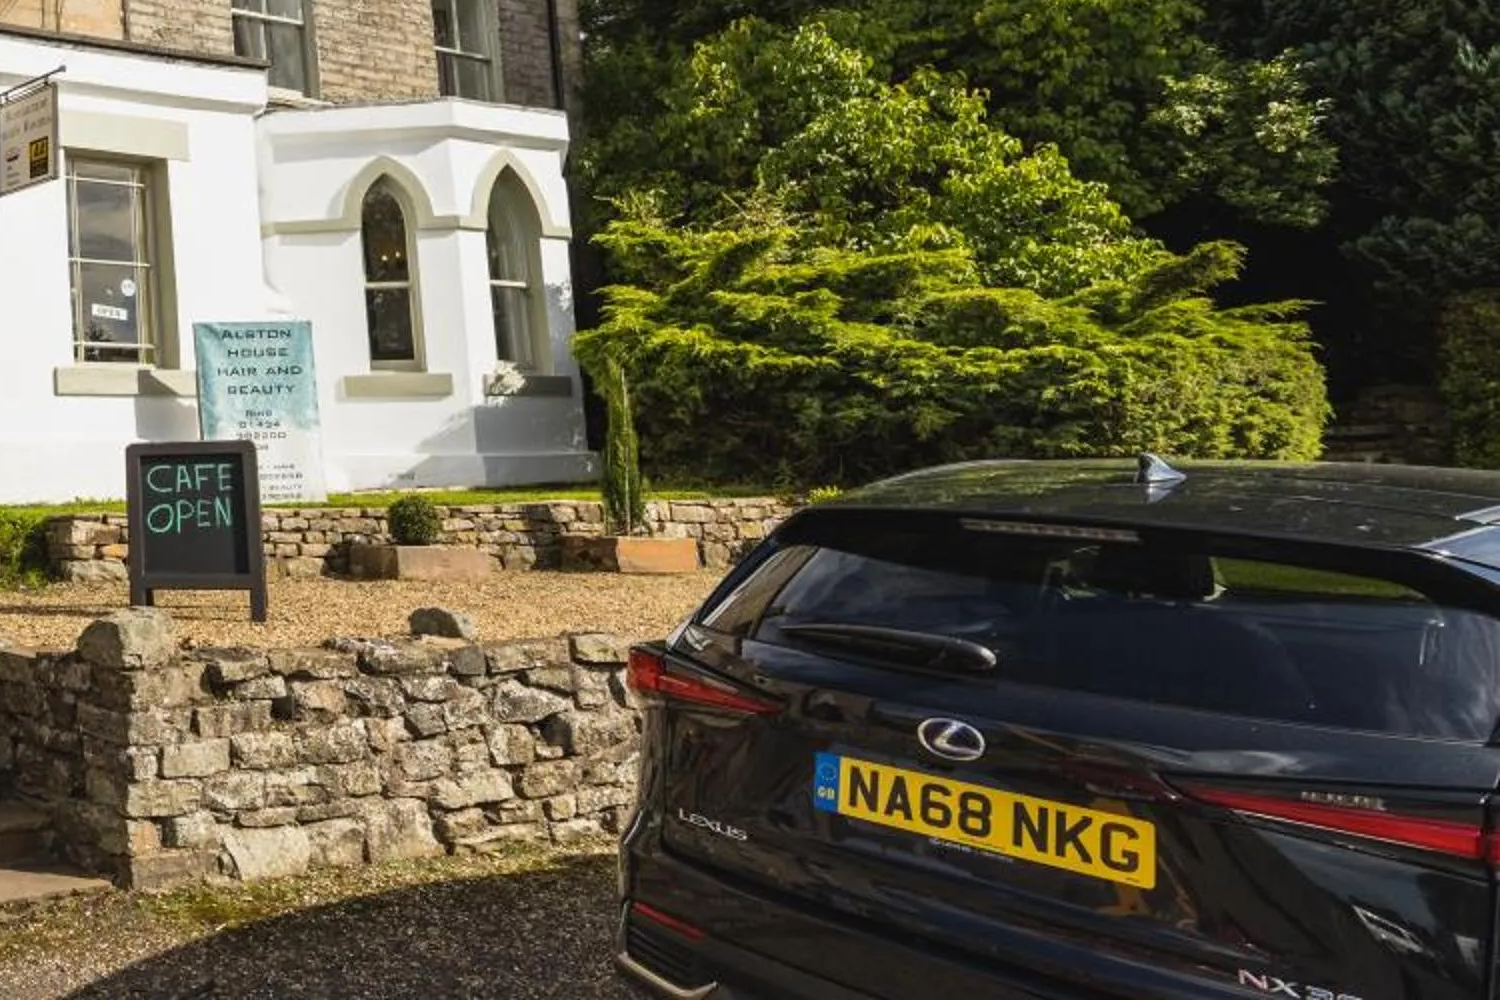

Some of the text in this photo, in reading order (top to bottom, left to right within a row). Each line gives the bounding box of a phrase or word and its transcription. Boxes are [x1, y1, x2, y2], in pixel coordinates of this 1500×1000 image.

[220, 328, 292, 340] ALSTON
[227, 347, 289, 358] HOUSE
[217, 365, 303, 377] HAIR AND
[227, 384, 296, 396] BEAUTY
[147, 463, 234, 493] CAFE
[147, 496, 233, 534] OPEN
[679, 807, 748, 841] LEXUS
[848, 765, 1140, 874] NA68 NKG
